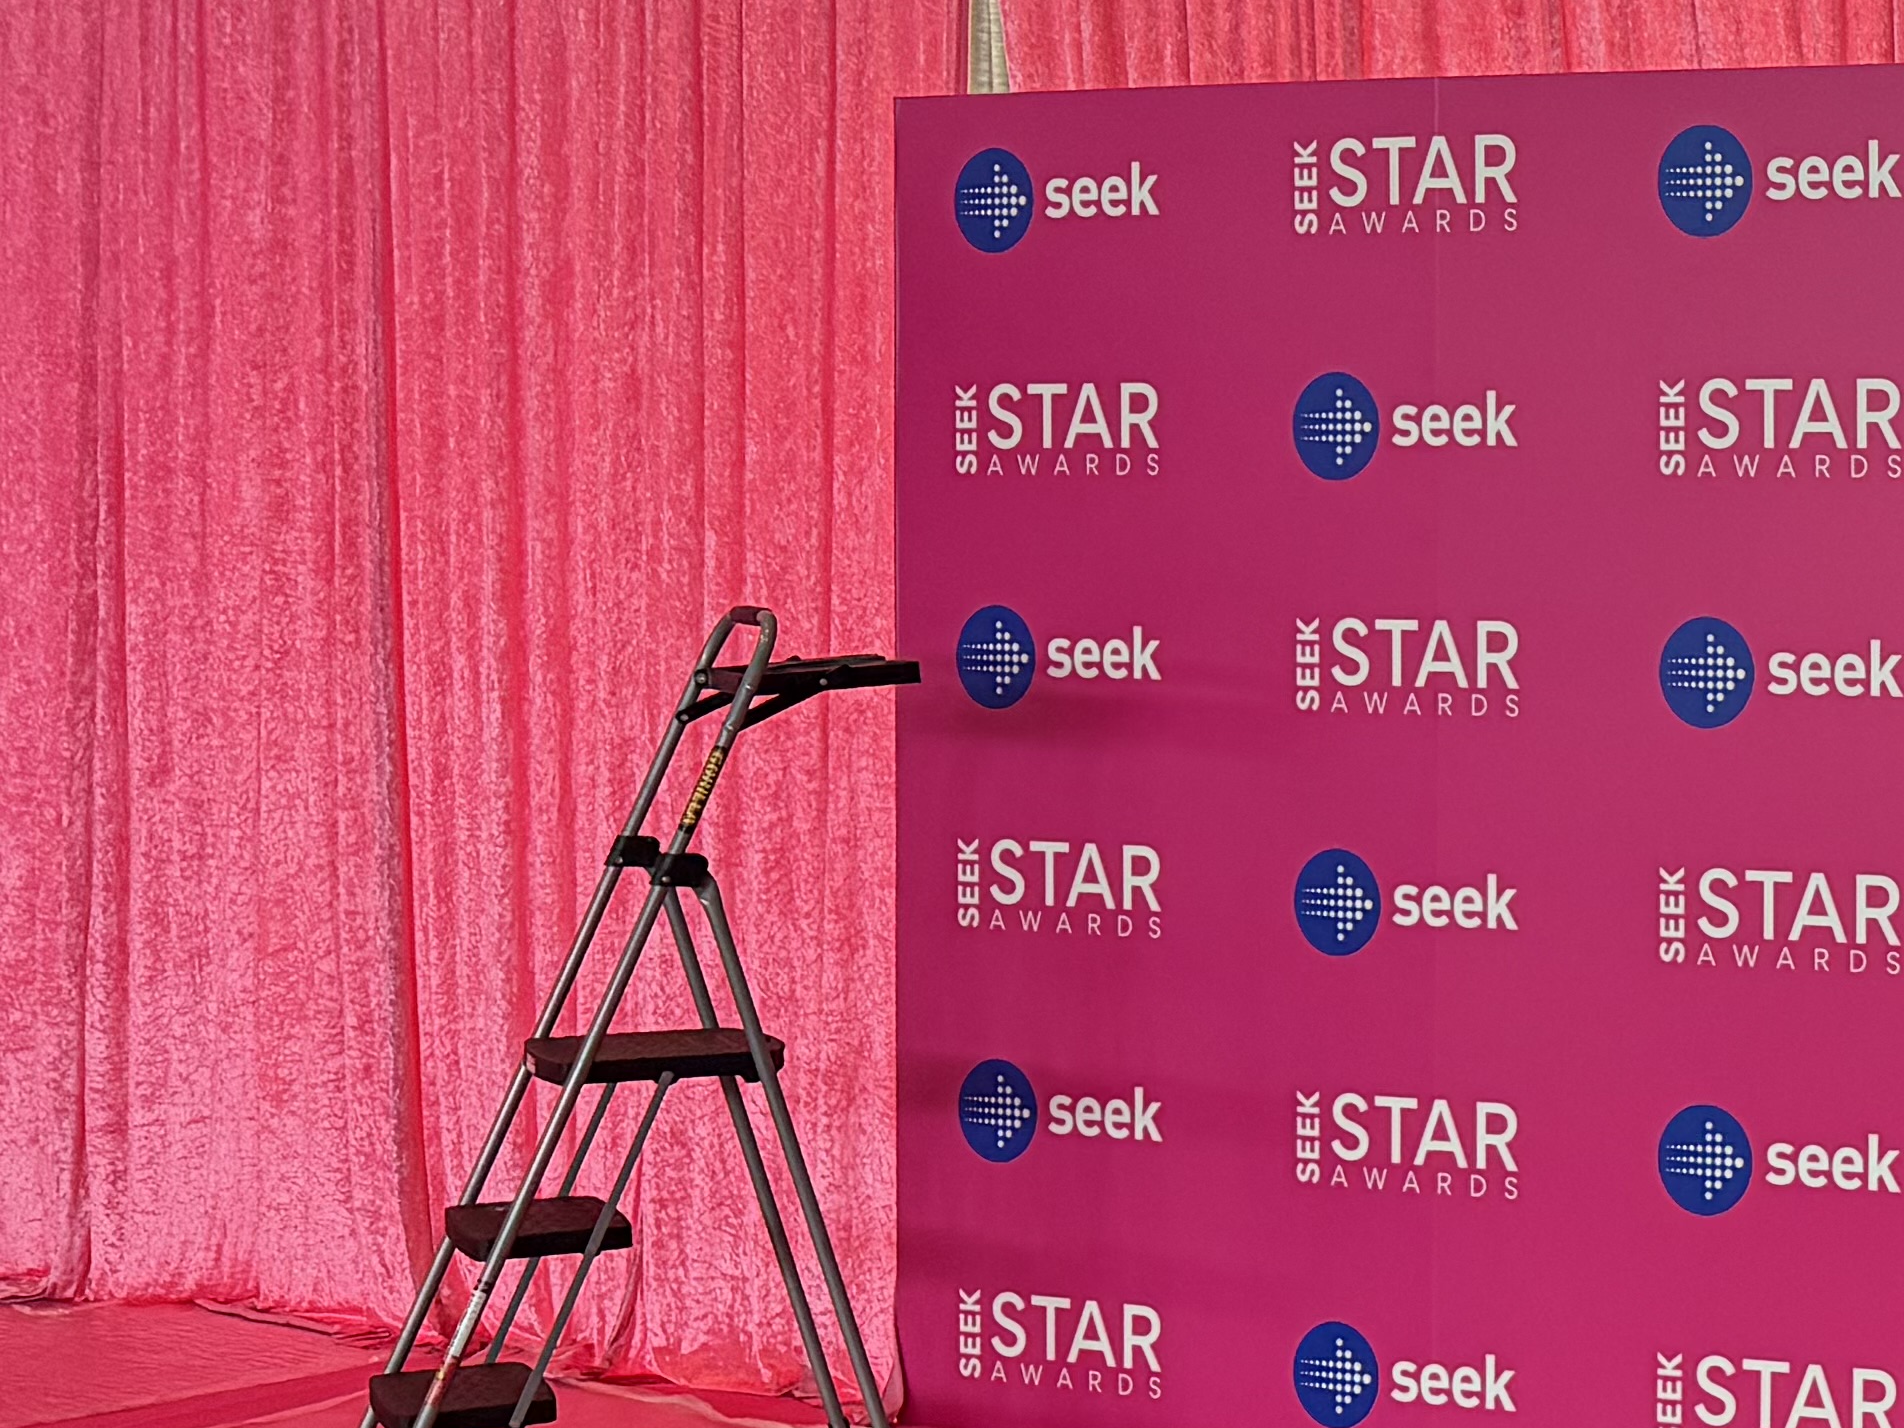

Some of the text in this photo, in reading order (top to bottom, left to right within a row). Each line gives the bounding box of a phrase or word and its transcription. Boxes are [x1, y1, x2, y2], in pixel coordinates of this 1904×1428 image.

[1043, 159, 1161, 220] seek
[1292, 138, 1320, 236] SEEK
[1327, 132, 1519, 209] STAR
[1764, 138, 1903, 202] seek
[1327, 206, 1519, 236] AWARDS
[953, 382, 979, 476] SEEK
[986, 381, 1161, 451] STAR
[1390, 388, 1519, 448] seek
[1658, 377, 1687, 478] SEEK
[1696, 376, 1903, 451] STAR
[985, 452, 1161, 477] AWARDS
[1696, 453, 1903, 480] AWARDS
[1045, 624, 1163, 682] seek
[1294, 616, 1322, 712] SEEK
[1329, 616, 1521, 691] STAR
[1766, 637, 1904, 699] seek
[1329, 689, 1520, 719] AWARDS
[956, 837, 981, 929] SEEK
[988, 837, 1163, 914] STAR
[1391, 872, 1520, 932] seek
[1695, 866, 1903, 948] STAR
[988, 907, 1162, 940] AWARDS
[1657, 865, 1687, 965] SEEK
[1695, 941, 1902, 976] AWARDS
[1046, 1085, 1164, 1144] seek
[1294, 1089, 1322, 1185] SEEK
[1329, 1091, 1520, 1174] STAR
[1329, 1163, 1520, 1201] AWARDS
[1764, 1132, 1903, 1195] seek
[957, 1287, 983, 1380] SEEK
[989, 1290, 1163, 1374] STAR
[989, 1359, 1163, 1401] AWARDS
[1389, 1352, 1518, 1414] seek
